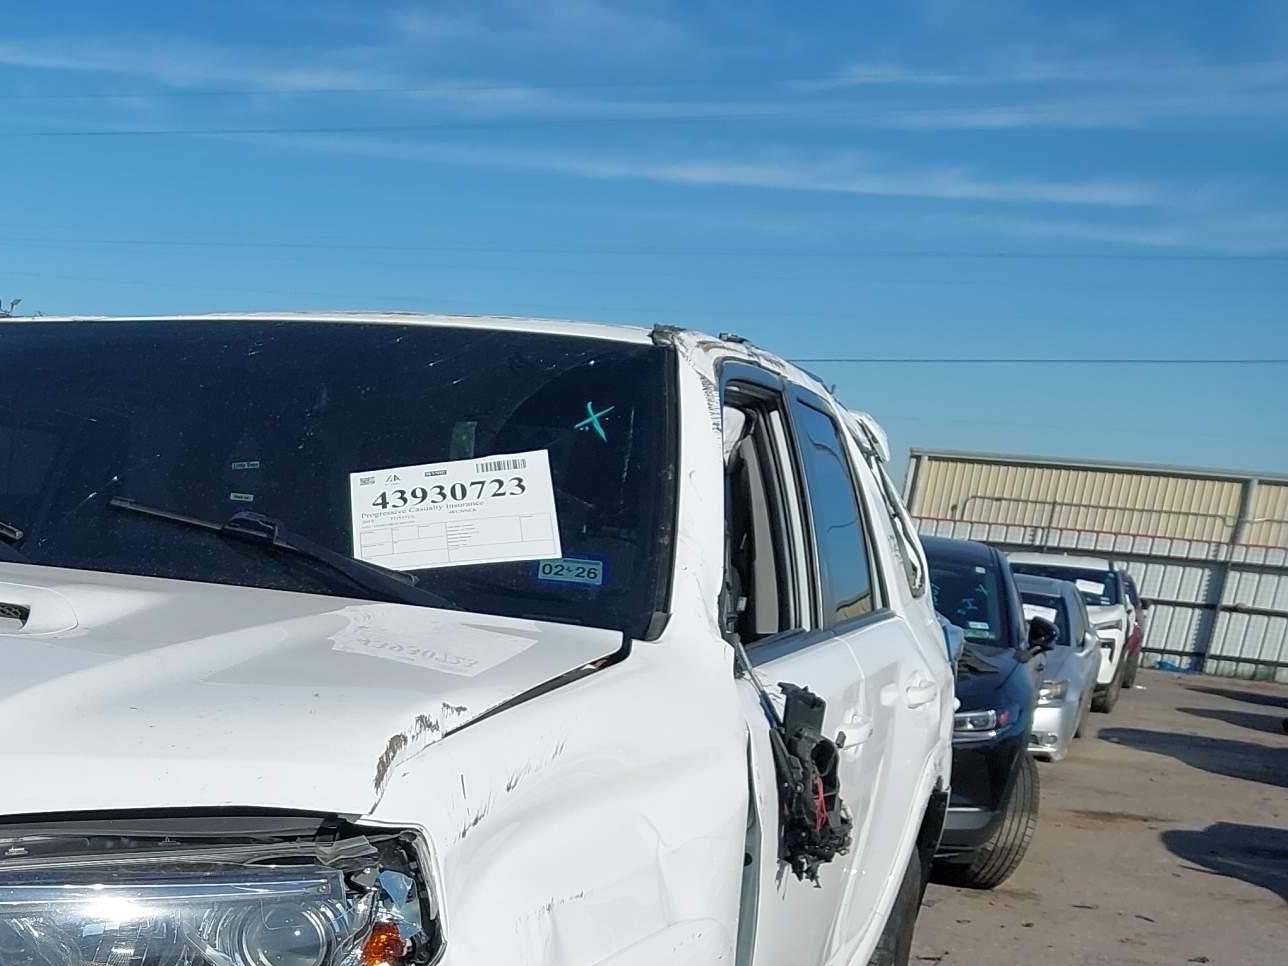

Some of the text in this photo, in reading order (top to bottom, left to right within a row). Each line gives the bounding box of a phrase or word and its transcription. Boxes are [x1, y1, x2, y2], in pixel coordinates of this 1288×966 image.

[372, 476, 527, 509] 43930723
[360, 500, 485, 520] Progressive Casualty Insurance
[542, 563, 598, 579] 02 26
